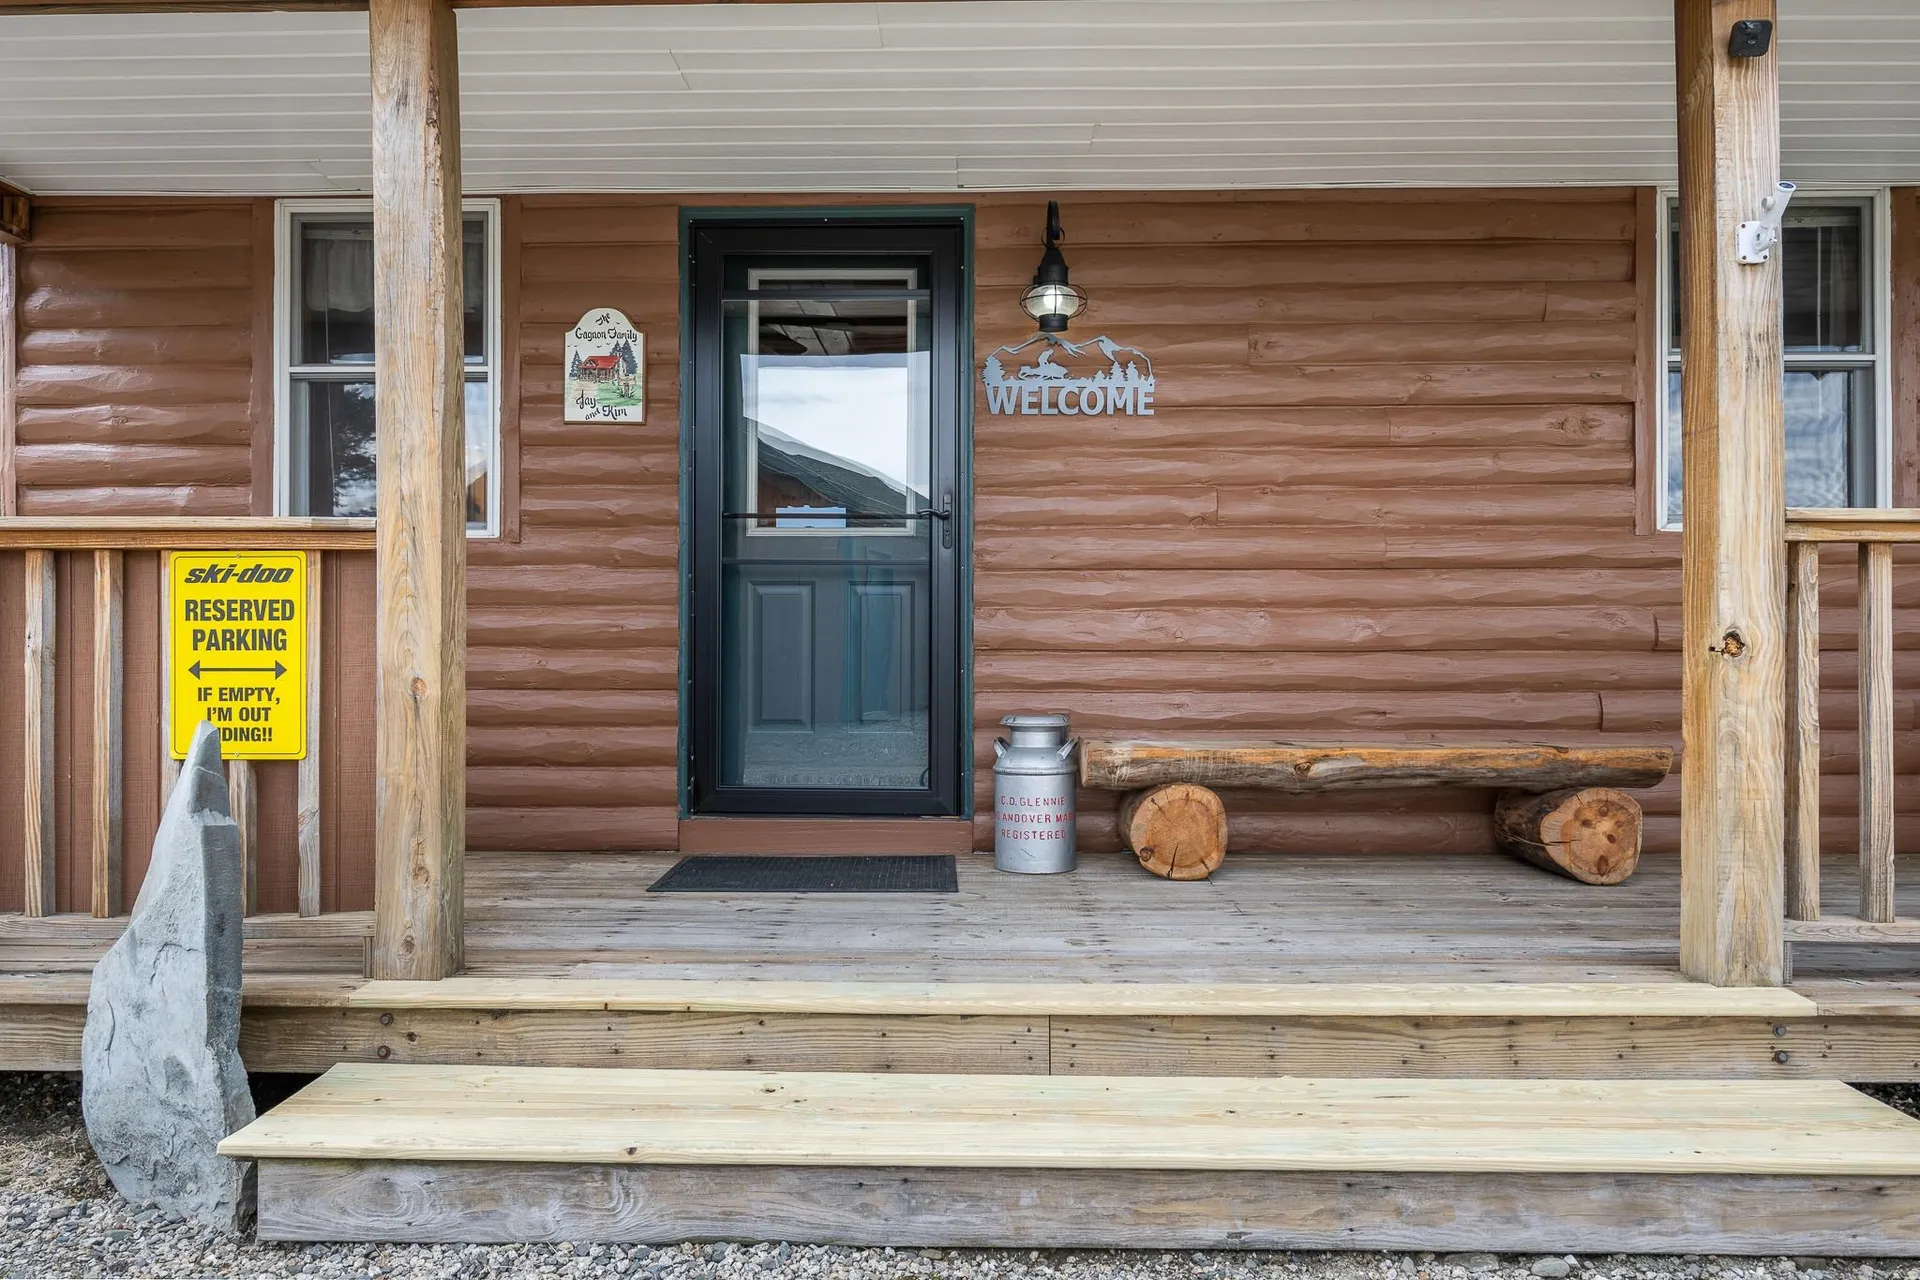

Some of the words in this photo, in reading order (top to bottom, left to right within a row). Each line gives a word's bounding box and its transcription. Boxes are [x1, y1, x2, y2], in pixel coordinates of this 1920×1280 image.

[575, 327, 607, 342] Gagnon
[607, 326, 638, 343] Family
[575, 389, 597, 410] Jay
[986, 385, 1155, 415] WELCOME
[585, 407, 601, 421] and
[602, 404, 628, 421] Kim
[184, 564, 294, 584] ski-doo
[184, 599, 295, 622] RESERVED
[192, 628, 288, 651] PARKING
[197, 687, 213, 702] IF
[218, 687, 280, 705] EMPTY,
[206, 707, 232, 722] I'M
[238, 707, 272, 722] OUT
[218, 727, 273, 742] DING!!
[1019, 796, 1065, 807] GLENNIE
[1002, 812, 1051, 823] ANDOVER
[1001, 829, 1066, 841] REGISTERED
